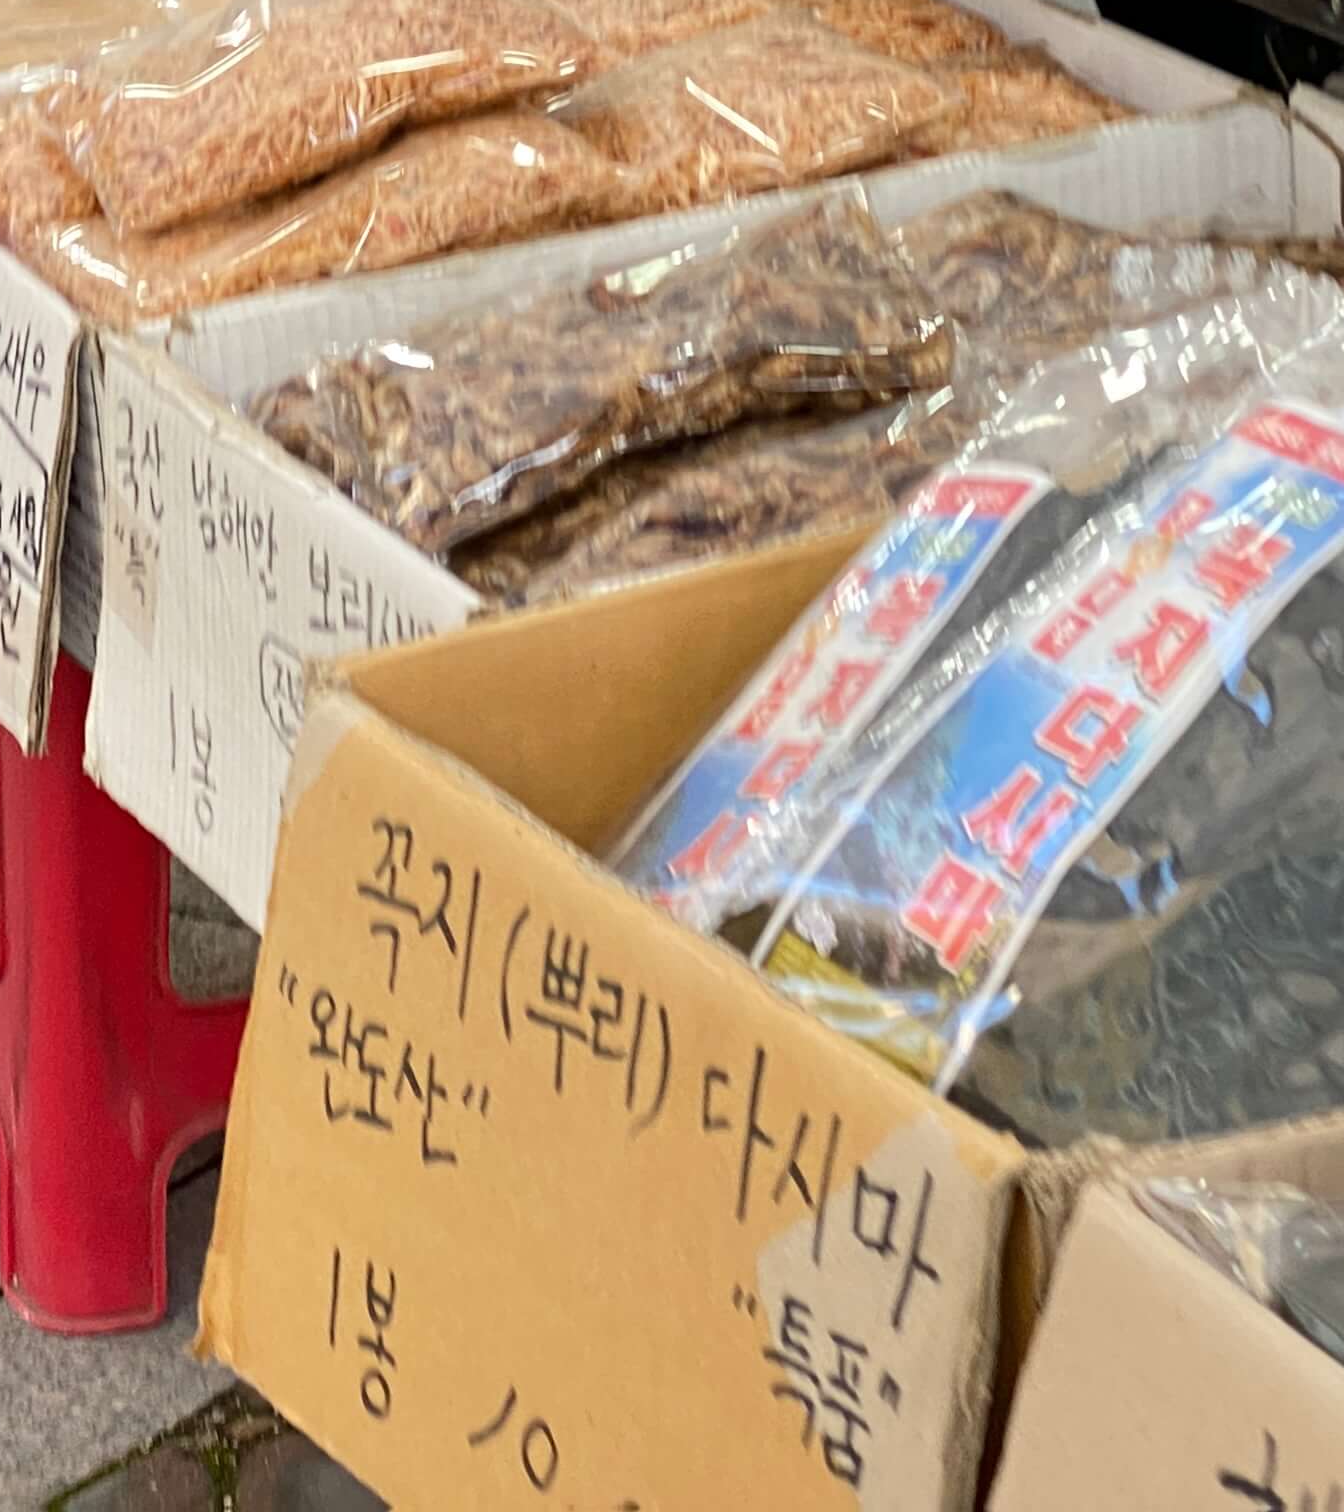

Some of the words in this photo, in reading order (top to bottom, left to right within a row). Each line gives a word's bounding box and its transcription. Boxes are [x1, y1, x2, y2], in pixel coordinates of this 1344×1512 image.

[117, 397, 164, 521] 국산
[309, 546, 435, 650] 보리새
[169, 685, 214, 833] 1봉
[901, 521, 1296, 976] 꼭지다시마
[278, 963, 491, 1167] "완도산"
[356, 817, 672, 1129] 꼭지(뿌리)
[701, 1046, 940, 1332] 다시마
[328, 1247, 398, 1418] 1봉
